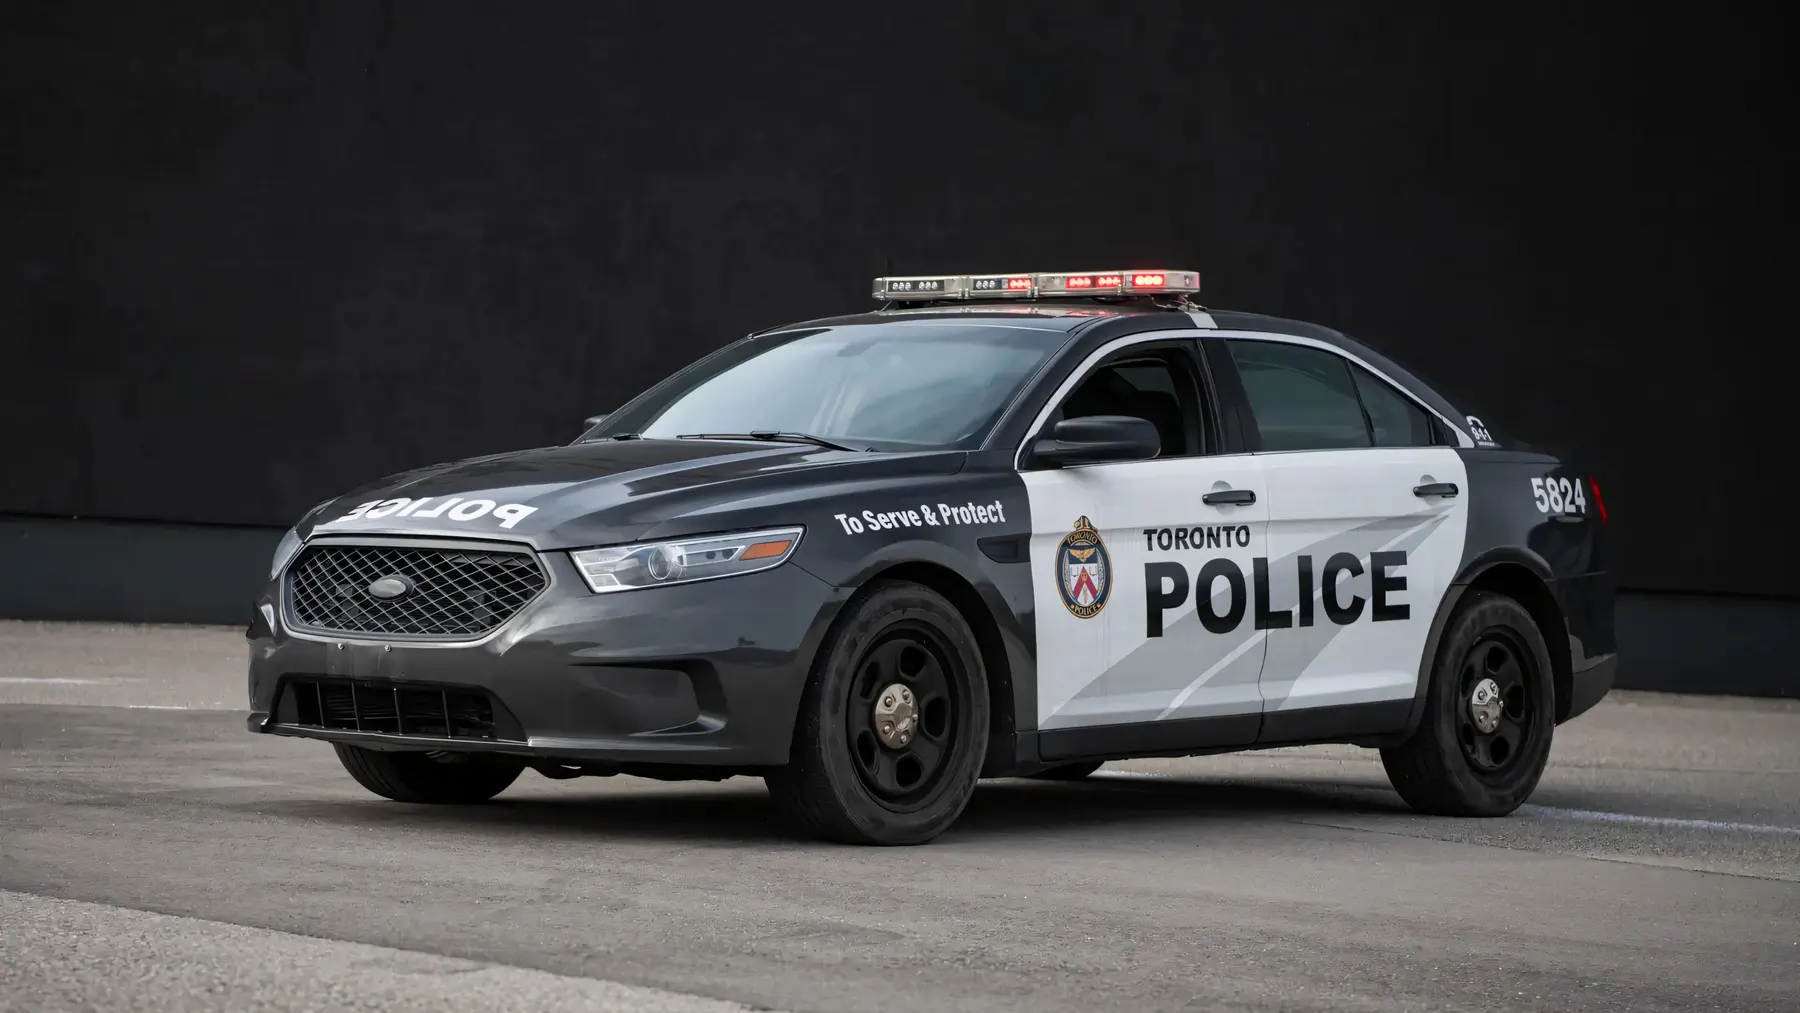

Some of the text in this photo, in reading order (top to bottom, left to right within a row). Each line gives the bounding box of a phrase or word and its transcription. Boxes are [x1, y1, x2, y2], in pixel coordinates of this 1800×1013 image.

[1530, 477, 1586, 514] 5824
[834, 500, 1006, 535] To Serve & Protect
[1067, 531, 1098, 544] TORONTO
[1143, 525, 1250, 551] TORONTO
[1144, 550, 1410, 638] POLICE
[1074, 604, 1097, 616] POLICE
